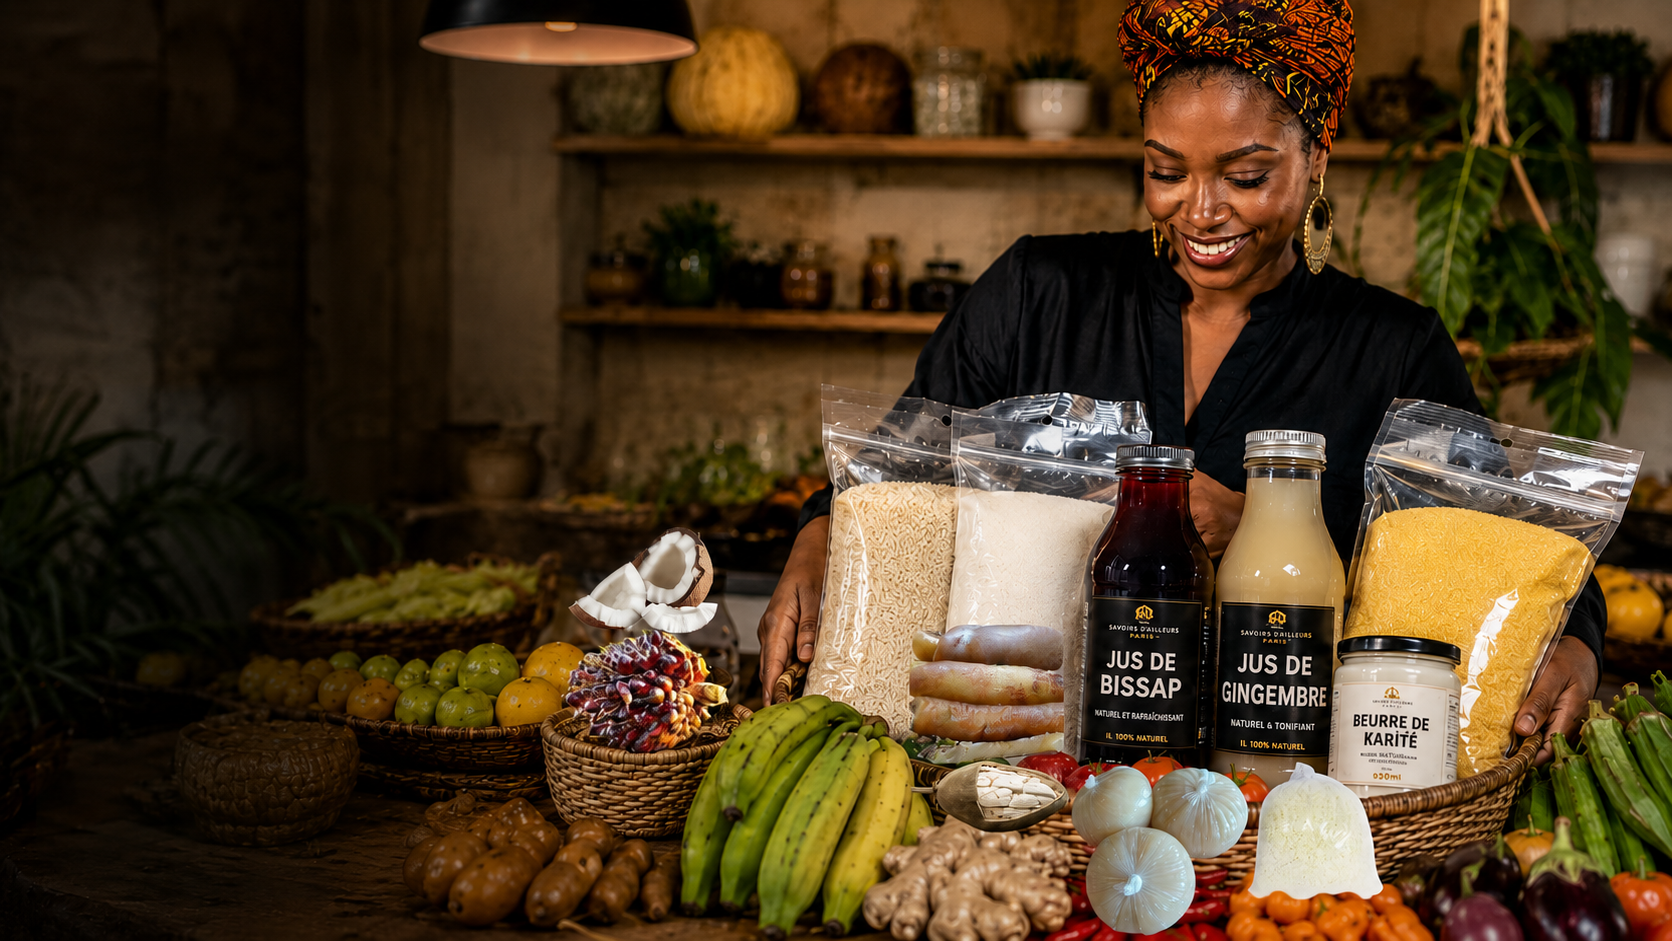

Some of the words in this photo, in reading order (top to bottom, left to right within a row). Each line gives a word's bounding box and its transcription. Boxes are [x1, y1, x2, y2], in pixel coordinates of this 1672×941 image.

[1108, 624, 1138, 632] SAVOIRS
[1140, 626, 1179, 634] D'AILLEURS
[1240, 629, 1271, 637] SAVOIRS
[1106, 650, 1144, 670] JUS
[1150, 652, 1176, 672] DE
[1237, 653, 1278, 675] JUS
[1285, 655, 1313, 676] DE
[1100, 673, 1182, 699] BISSAP
[1222, 681, 1327, 707] GINGEMBRE
[1094, 709, 1121, 719] NATUREL
[1122, 711, 1130, 720] ET
[1230, 719, 1265, 729] NATUREL
[1266, 721, 1273, 730] &
[1274, 722, 1316, 731] TONIFIANT
[1353, 714, 1408, 729] BEURRE
[1411, 716, 1430, 732] DE
[1115, 733, 1135, 741] 100%
[1136, 735, 1168, 743] NATUREL
[1249, 740, 1270, 749] 100%
[1271, 742, 1306, 751] NATUREL
